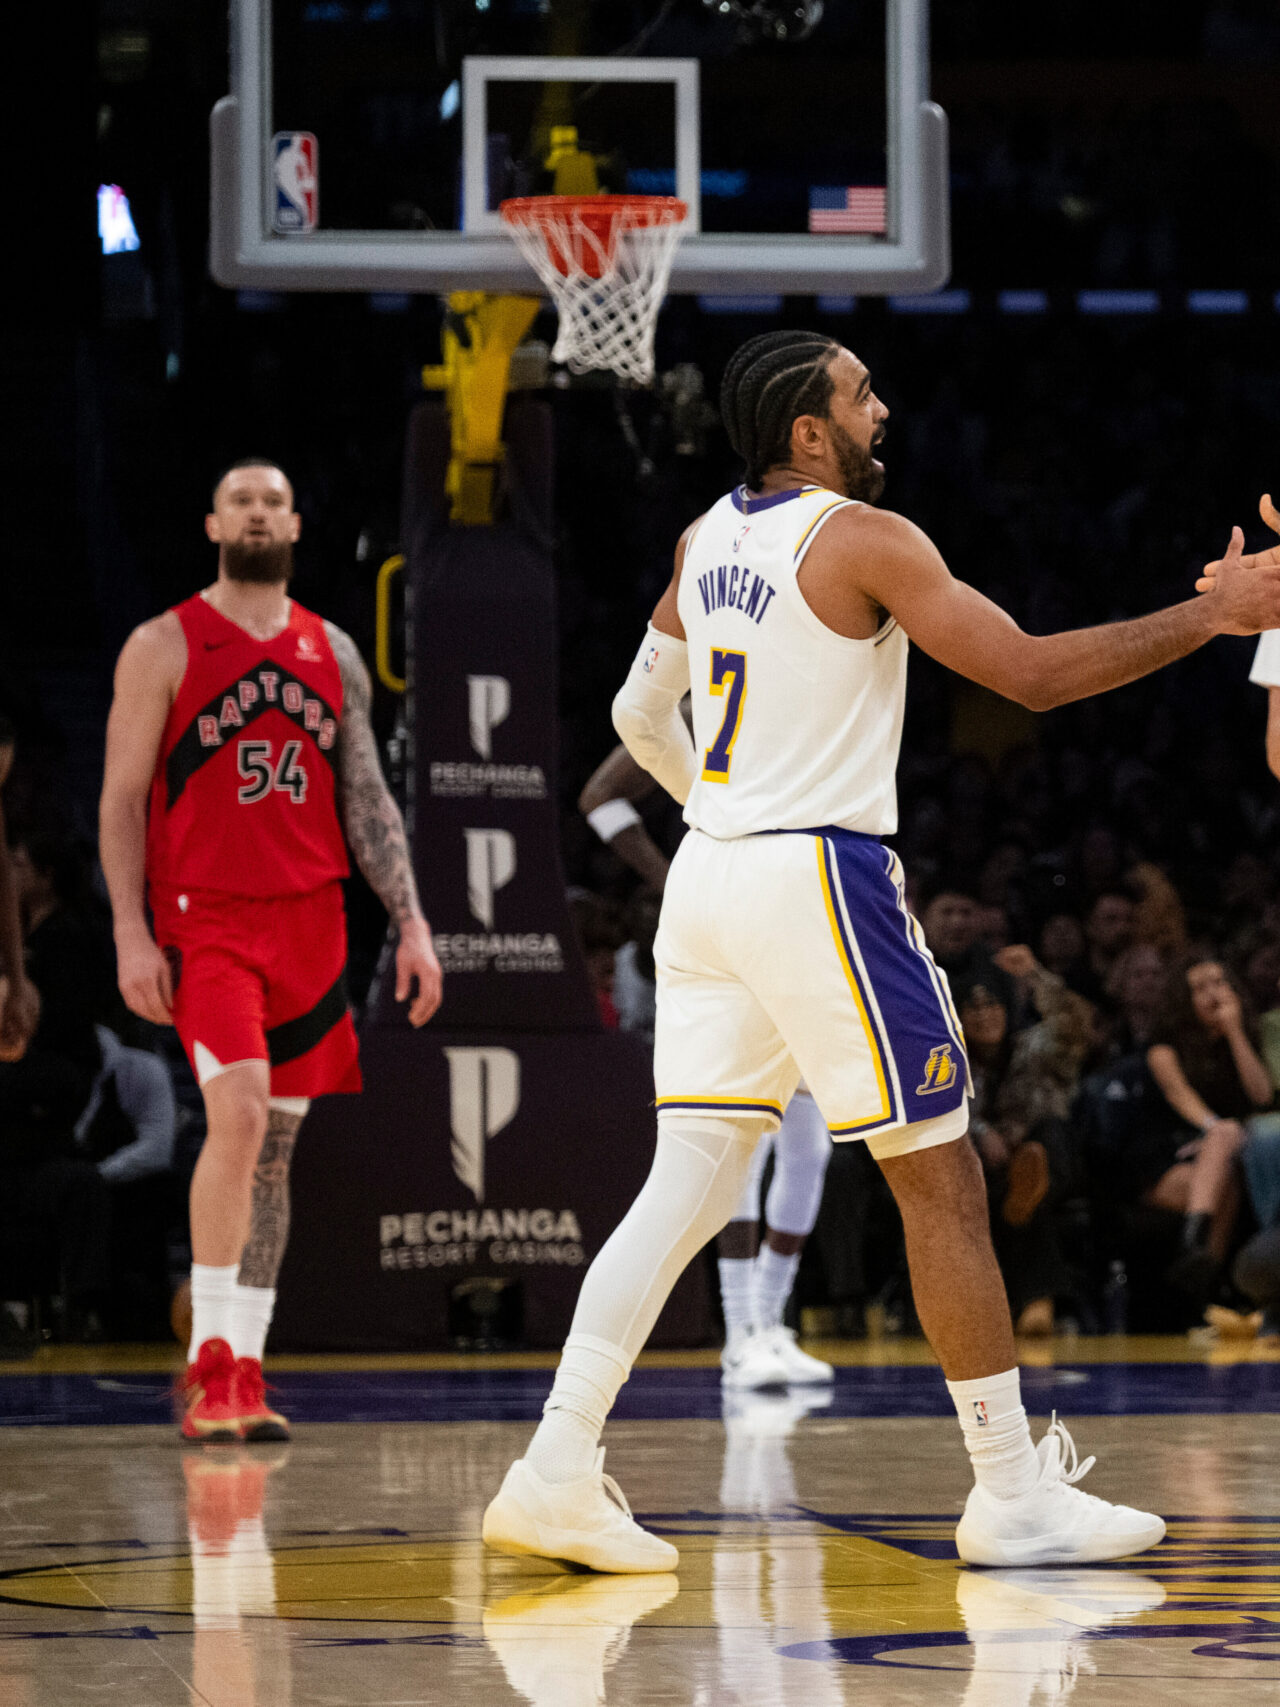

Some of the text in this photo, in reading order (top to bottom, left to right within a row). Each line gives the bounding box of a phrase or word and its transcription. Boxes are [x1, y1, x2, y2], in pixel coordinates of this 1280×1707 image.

[698, 565, 776, 624] VINCENT
[198, 671, 337, 750] RAPTORS
[701, 646, 748, 785] 7
[238, 739, 308, 805] 54
[430, 761, 546, 783] PECHANGA
[432, 933, 563, 957] ECHANGA
[441, 957, 489, 973] SORT
[380, 1208, 583, 1247] PECHANGA
[380, 1240, 586, 1271] RESORT CASINO
